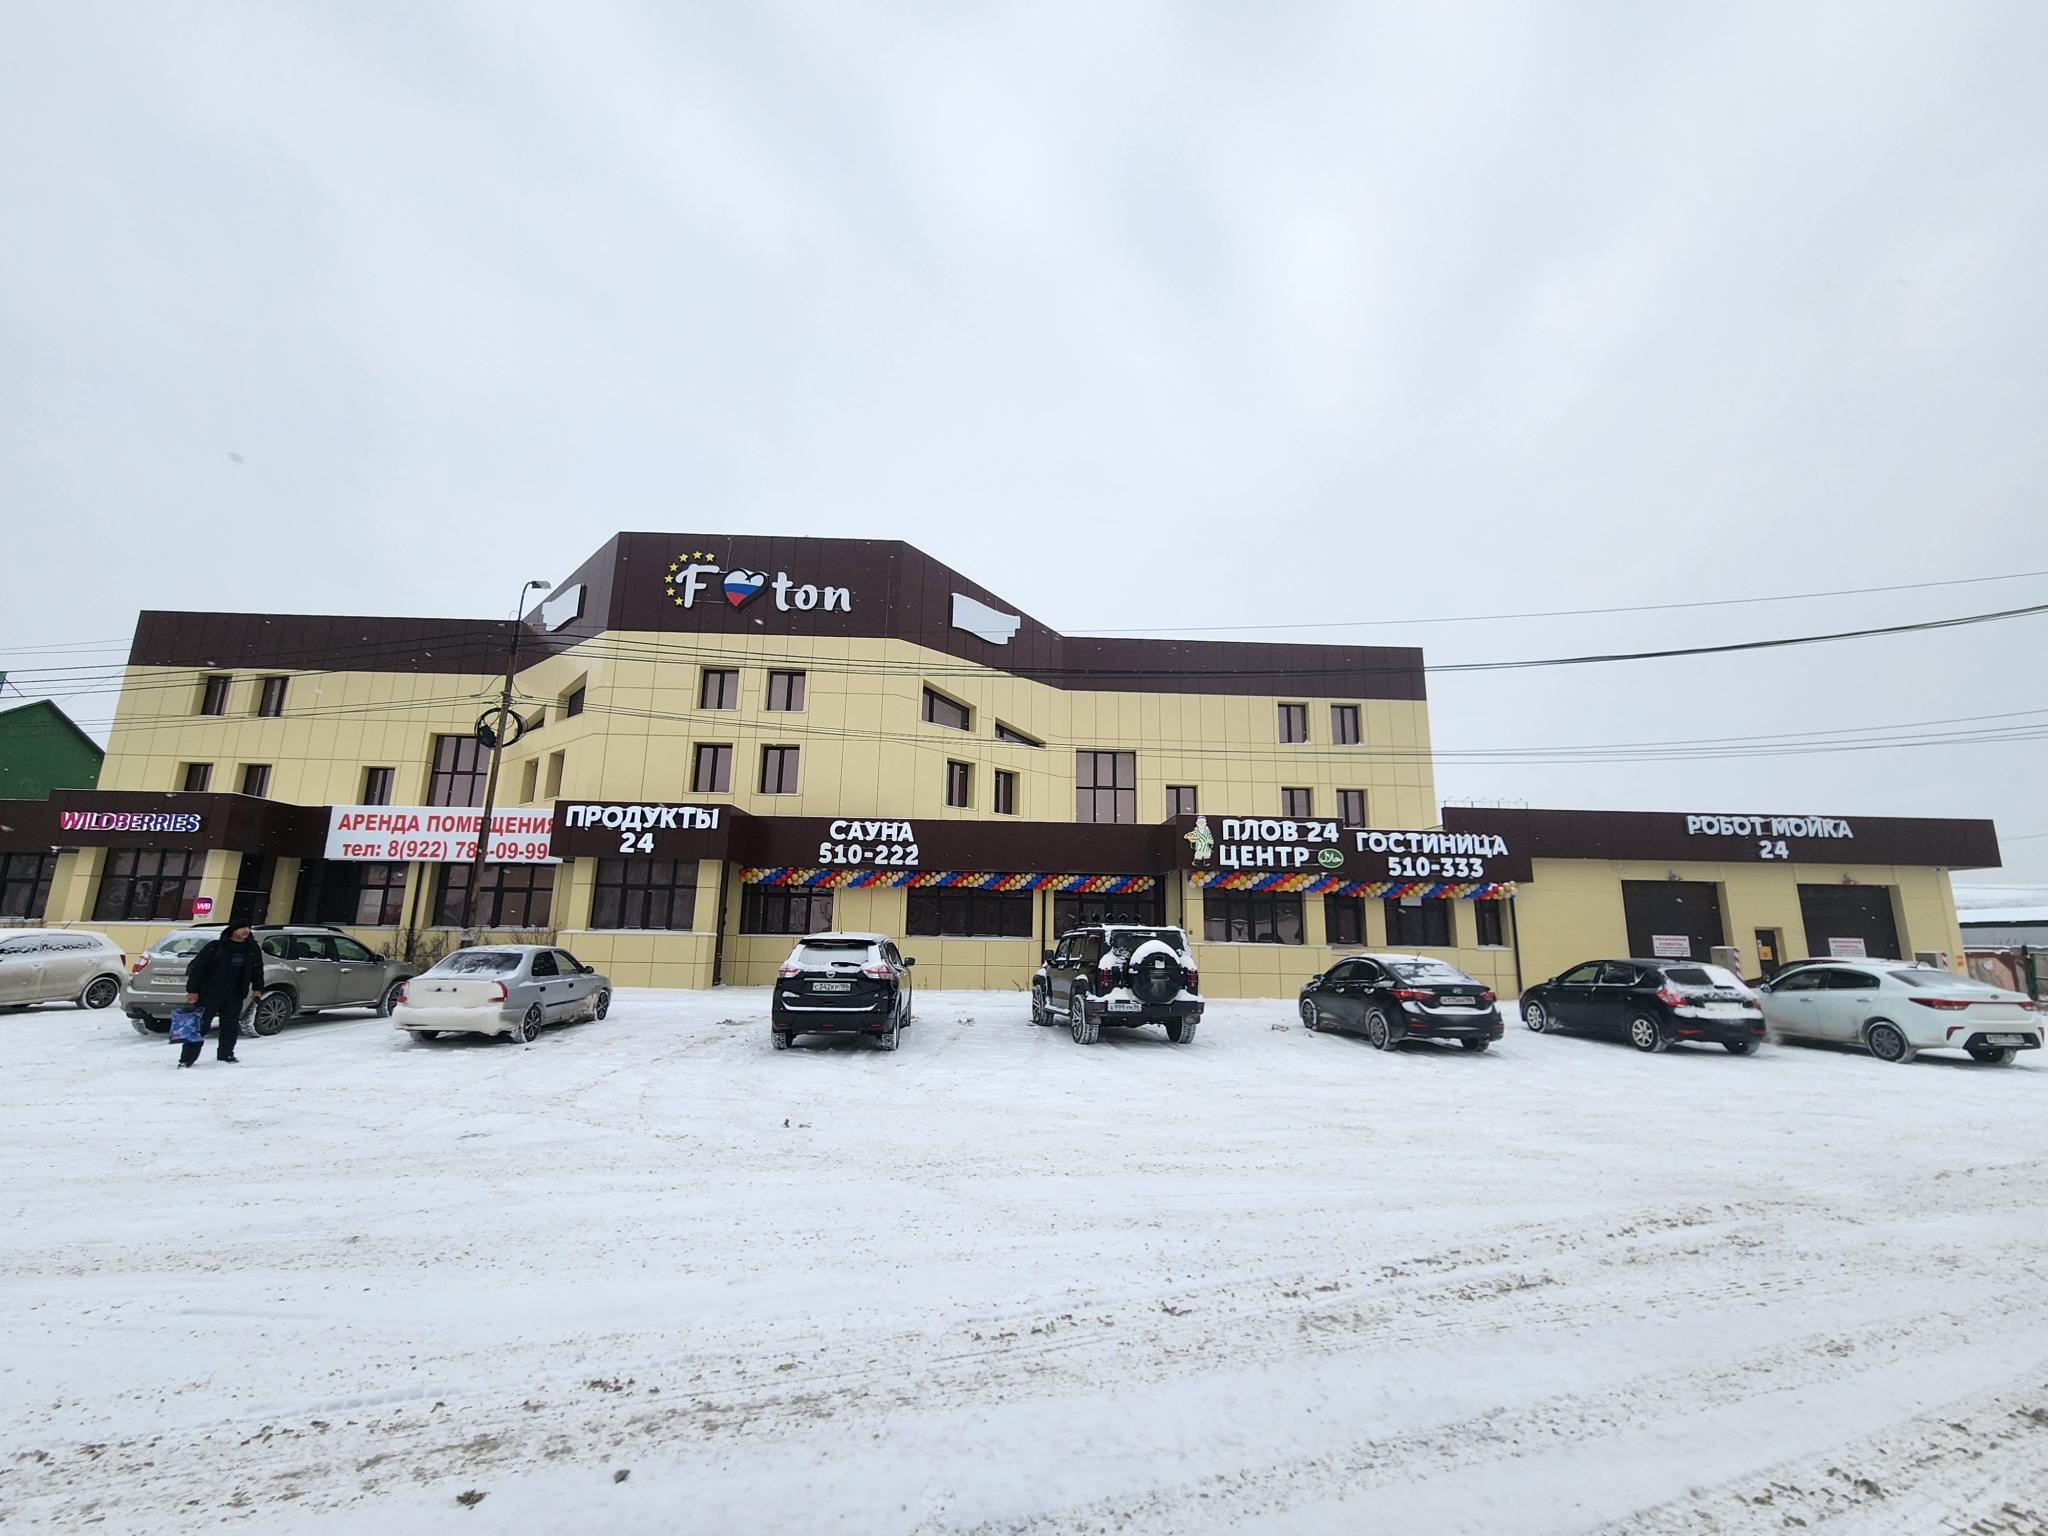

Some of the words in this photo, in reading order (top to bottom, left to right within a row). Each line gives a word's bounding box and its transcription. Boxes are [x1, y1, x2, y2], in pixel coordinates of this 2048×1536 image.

[60, 811, 202, 832] WILDBERRIES
[338, 814, 420, 835] АРЕНДА
[565, 805, 720, 832] ПРОДУКТЫ
[1687, 815, 1763, 836] РОБОТ
[1771, 815, 1854, 838] МОЙКА
[829, 820, 915, 842] САУНА
[1222, 819, 1299, 842] ПЛОВ
[1306, 822, 1339, 843] 24
[342, 843, 381, 857] тел:
[387, 840, 448, 861] 8(922)
[455, 841, 548, 860] 78-09-99
[619, 832, 655, 854] 24
[818, 841, 919, 865] 510-222
[1356, 832, 1509, 858] ГОСТИНИЦА
[1759, 840, 1790, 859] 24
[1219, 844, 1310, 870] ЦЕНТР
[1387, 856, 1484, 878] 510-333
[196, 902, 211, 910] WB
